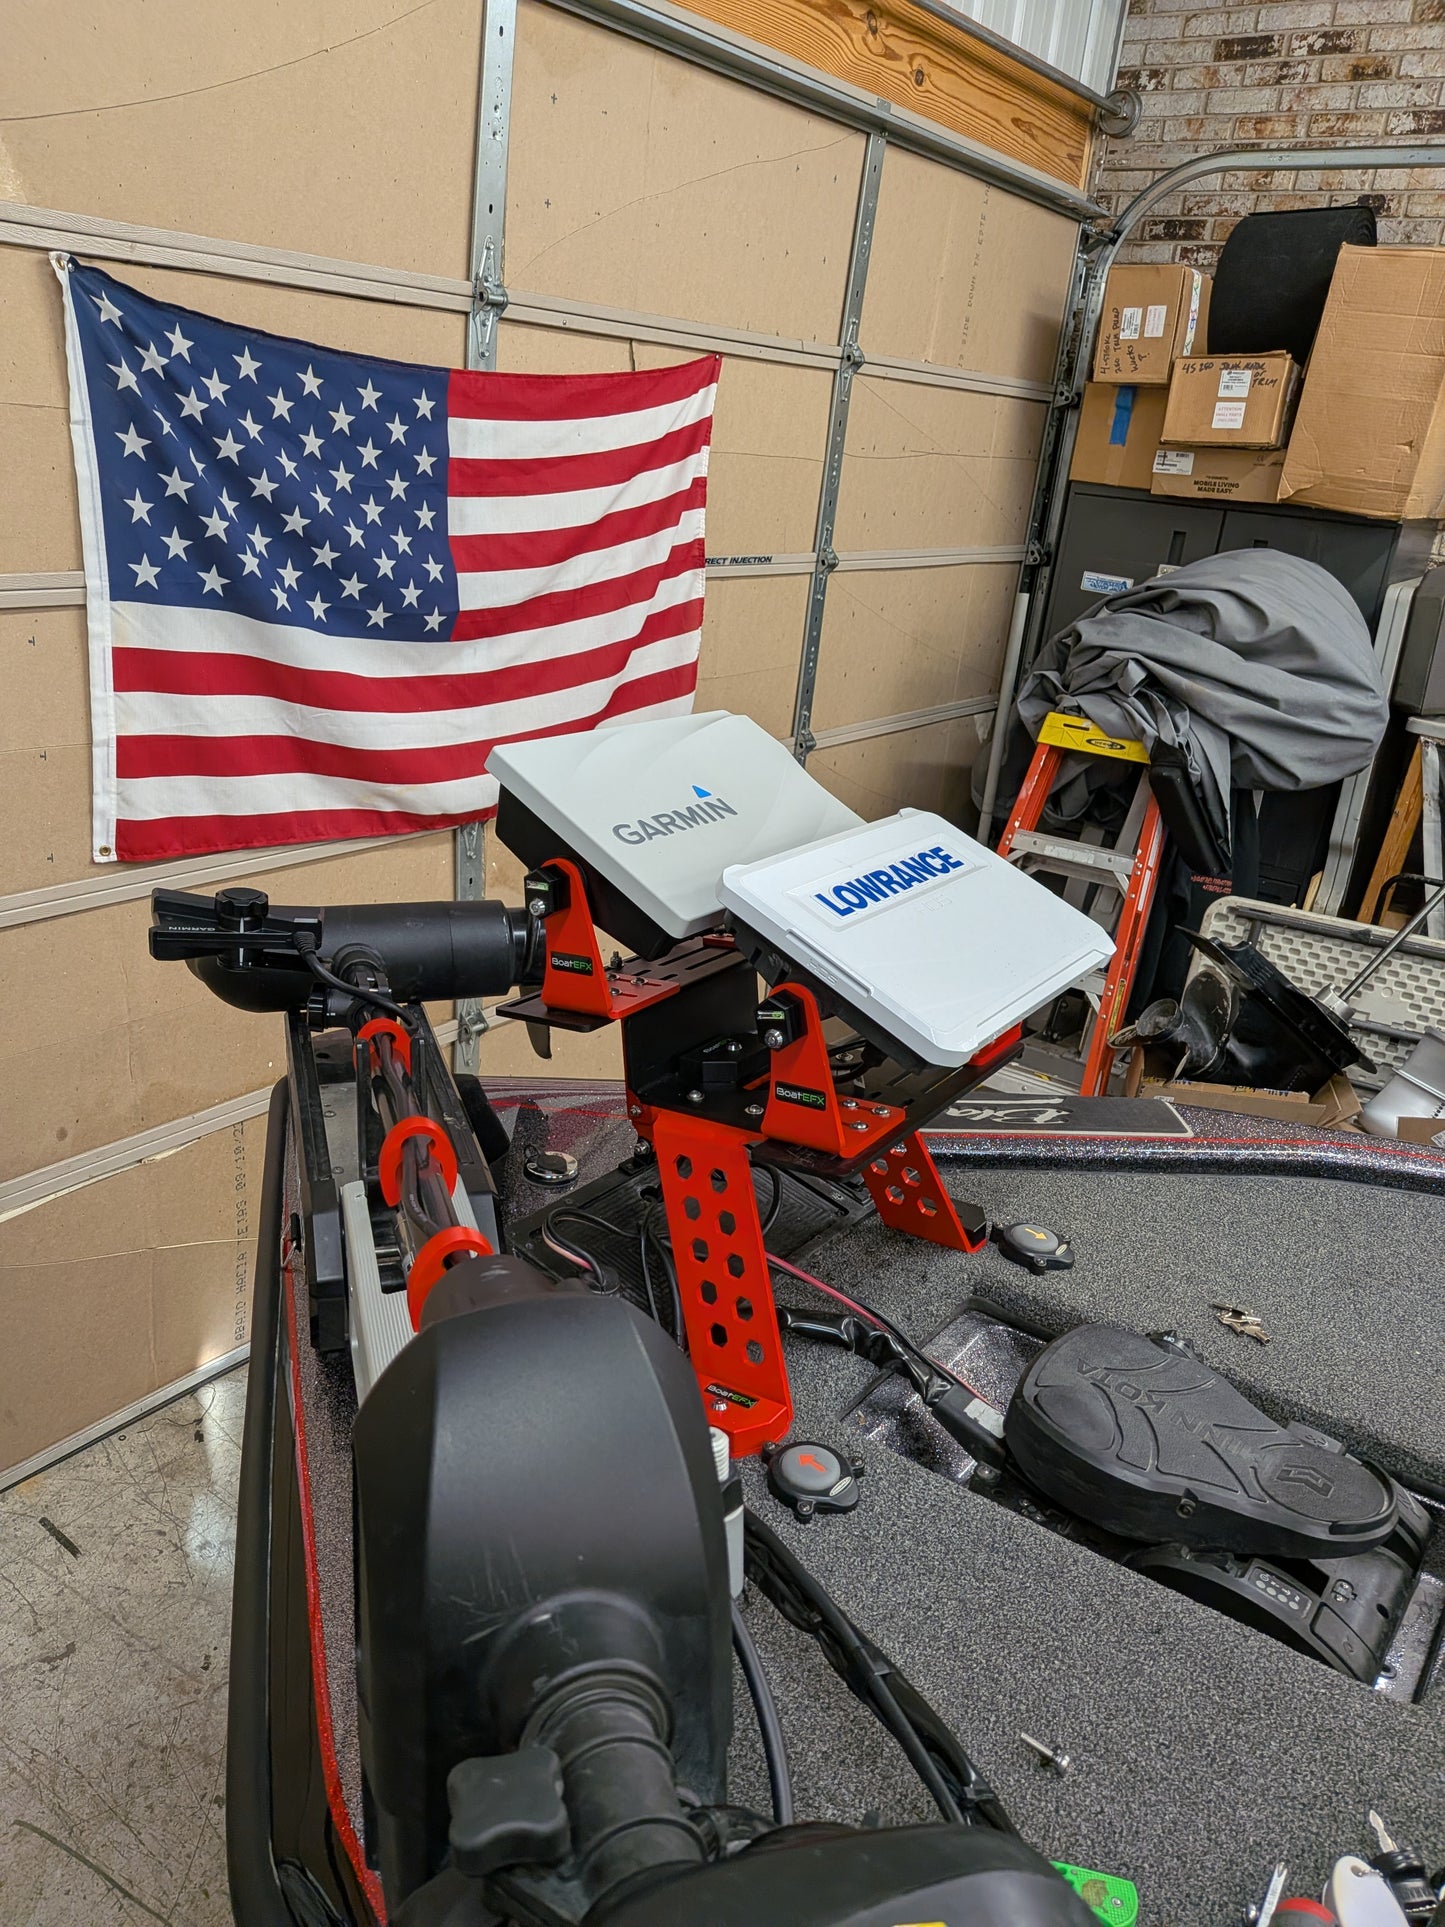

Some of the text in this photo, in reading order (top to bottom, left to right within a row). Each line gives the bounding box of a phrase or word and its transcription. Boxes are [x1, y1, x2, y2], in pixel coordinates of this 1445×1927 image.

[962, 315, 970, 345] SIDE
[967, 275, 976, 307] DOWN
[1193, 480, 1240, 489] MOBILE LIVING
[729, 555, 773, 564] INJECTION
[611, 797, 738, 846] GARMIN
[813, 845, 965, 918] LOWRANCE
[551, 957, 592, 971] BoatEFX
[776, 1086, 825, 1106] BoatEFX
[707, 1384, 755, 1406] BoatEFX
[1076, 1357, 1169, 1416] KOTA
